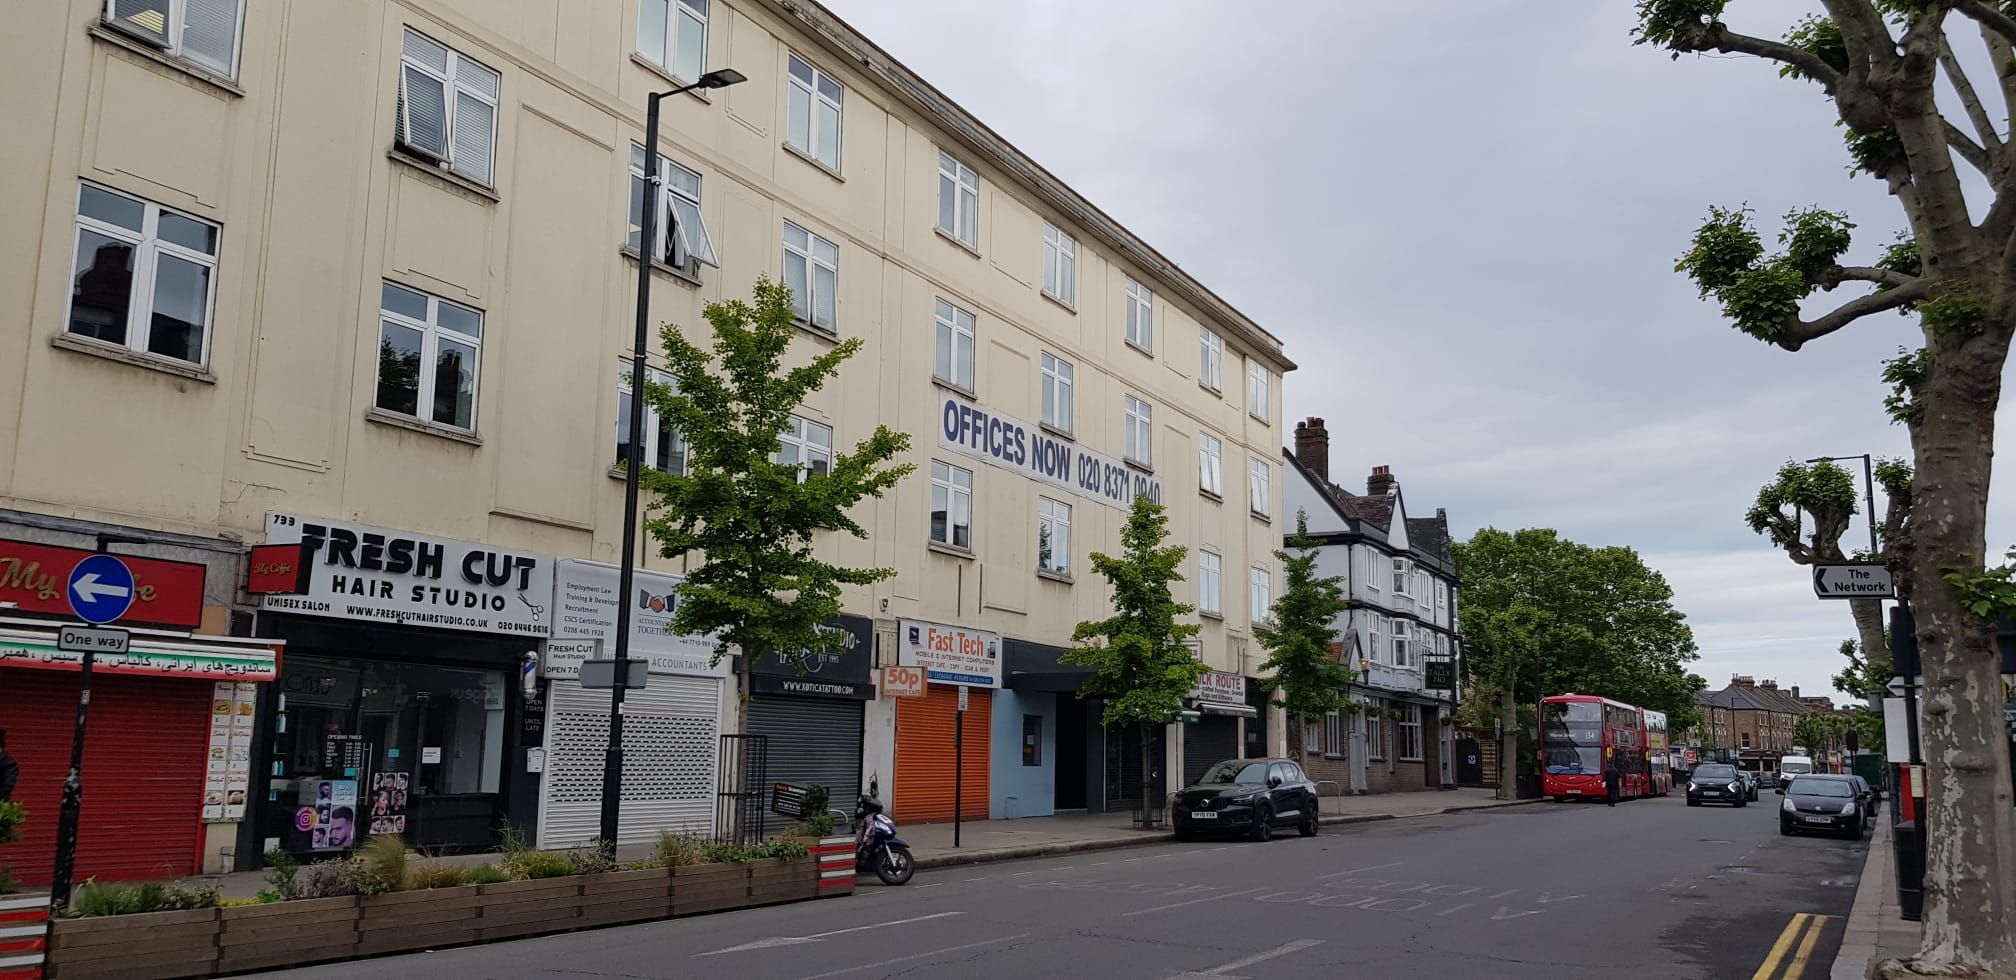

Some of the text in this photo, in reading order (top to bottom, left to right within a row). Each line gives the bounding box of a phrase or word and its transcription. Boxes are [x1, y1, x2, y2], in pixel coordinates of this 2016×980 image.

[944, 400, 1025, 465] OFFICES
[1031, 434, 1070, 482] NOW
[1078, 453, 1100, 494] 020
[1104, 463, 1130, 504] 8371
[273, 515, 295, 527] 733
[301, 523, 536, 590] FRESH CUT
[1848, 569, 1870, 579] The
[332, 575, 506, 612] HAIR STUDIO
[566, 582, 600, 593] Employment
[1834, 582, 1886, 592] Network
[566, 593, 587, 603] Training
[267, 596, 300, 610] UNISEX
[302, 600, 330, 612] SALON
[347, 604, 488, 629] WWW.FRESHCUTHAIRSTUDIO.CO.UK
[498, 621, 513, 631] 020
[565, 604, 598, 614] Recruitment
[579, 617, 612, 627] Certification
[564, 625, 578, 634] 0208
[579, 628, 590, 636] 445
[64, 632, 124, 649] One way
[928, 627, 984, 656] Fast Tech
[548, 644, 575, 652] FRESH
[651, 656, 708, 672] ACCOUNTANTS
[888, 668, 919, 689] 50p
[1196, 673, 1241, 690] ILK ROUTE
[783, 681, 854, 695] WWW.XOTICATATTOO.COM
